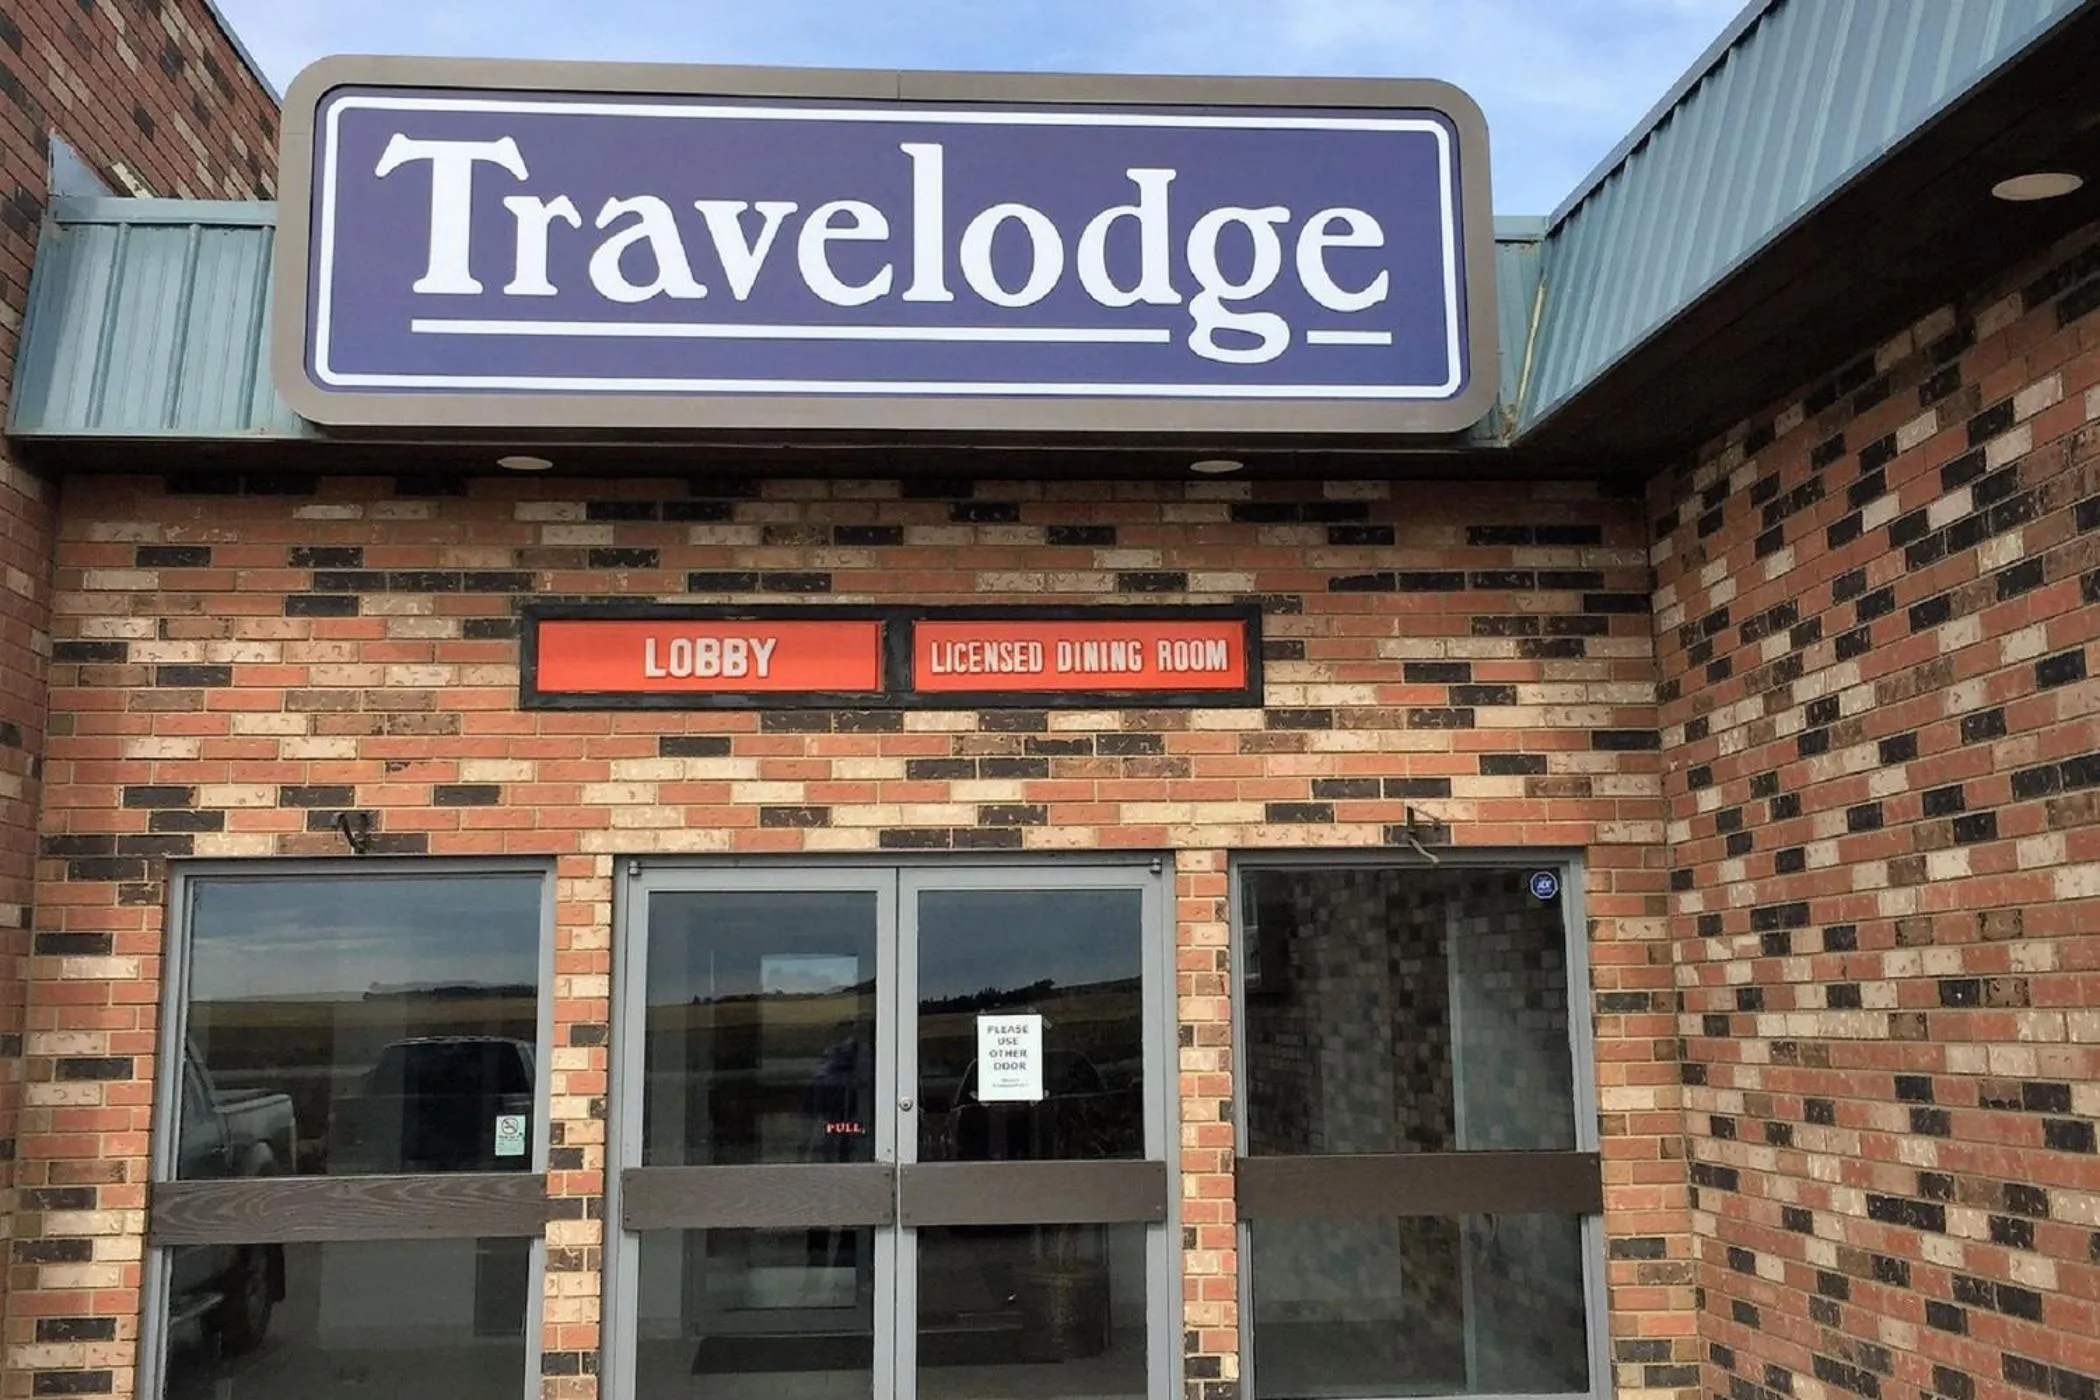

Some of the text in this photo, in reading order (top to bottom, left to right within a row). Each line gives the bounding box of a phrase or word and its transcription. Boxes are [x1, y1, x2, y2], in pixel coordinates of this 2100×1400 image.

[375, 132, 1390, 364] Travelodge
[644, 637, 777, 678] LOBBY
[930, 639, 1228, 674] LICENSED DINING ROOM
[987, 1025, 1029, 1034] PLEASE
[997, 1037, 1019, 1046] USE
[988, 1049, 1027, 1058] OTHER
[993, 1062, 1027, 1071] DOOR
